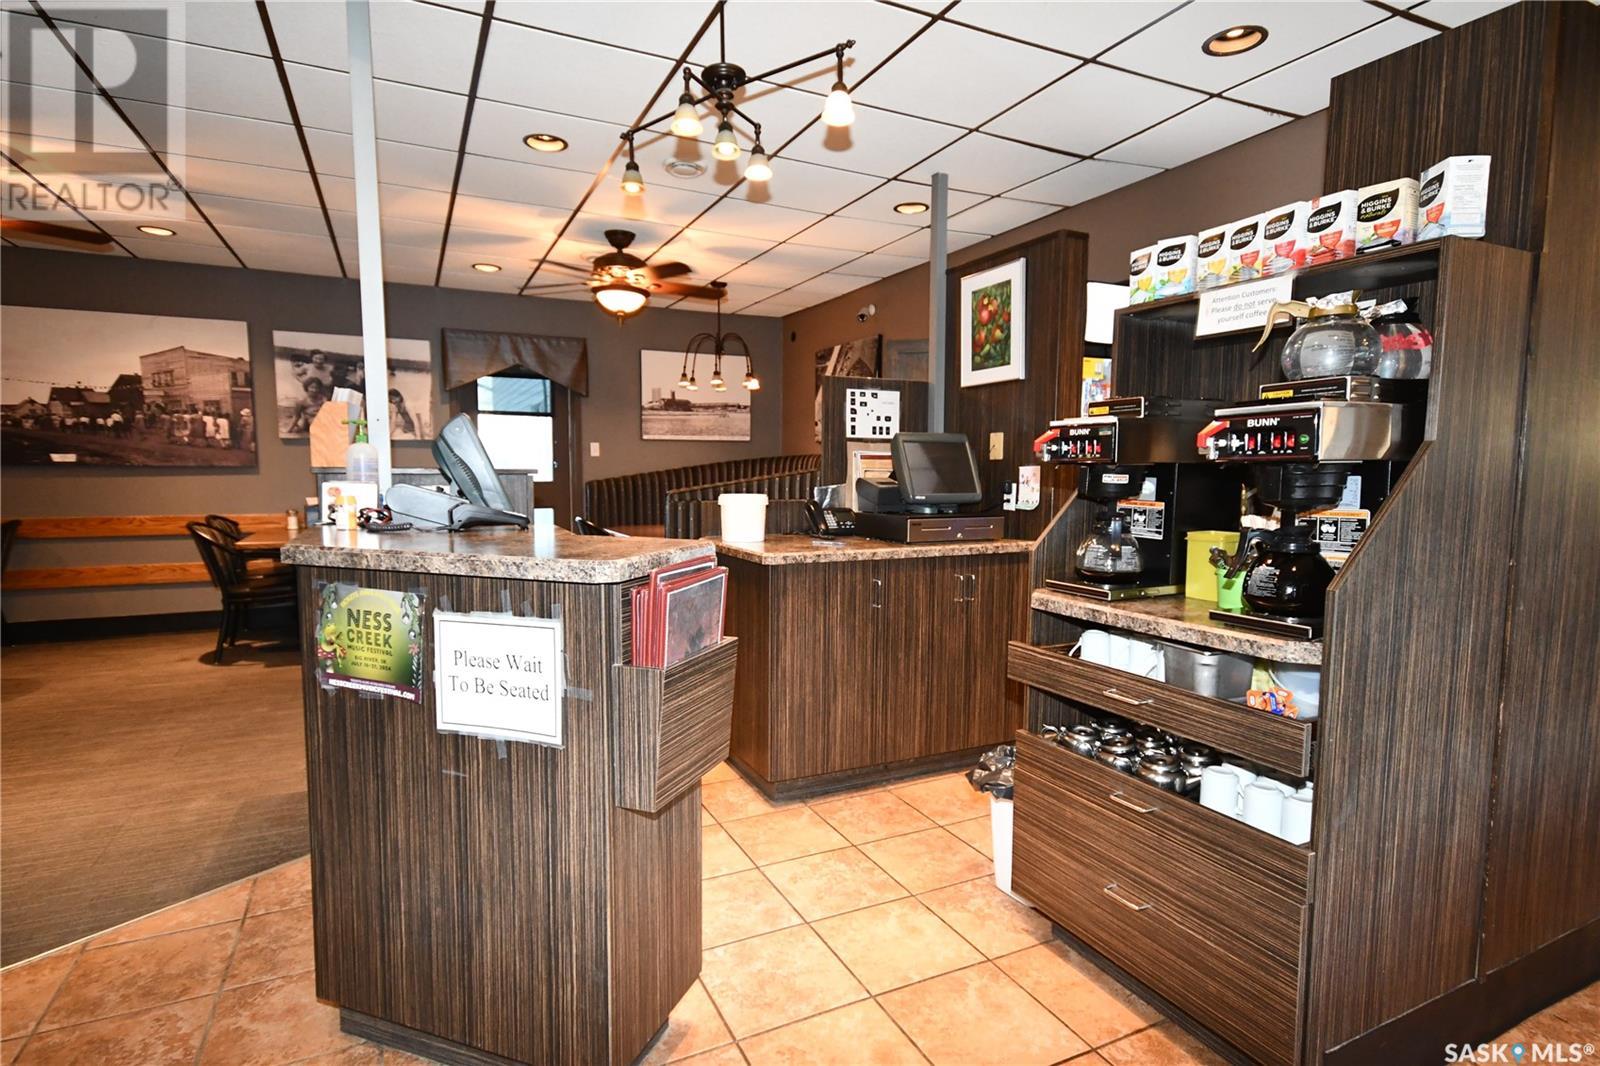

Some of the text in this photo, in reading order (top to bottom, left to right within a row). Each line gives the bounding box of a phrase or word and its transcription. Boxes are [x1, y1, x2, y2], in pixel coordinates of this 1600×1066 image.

[1361, 197, 1392, 208] HIGGINS
[1367, 203, 1392, 212] BURKE
[1212, 294, 1240, 303] Attention
[1211, 304, 1231, 313] Please
[1233, 303, 1243, 311] do
[1244, 301, 1256, 309] not
[1217, 312, 1244, 324] yourself
[346, 608, 392, 632] NESS
[347, 628, 392, 649] CREEK
[347, 644, 393, 657] MUSIC FESTIVAL
[454, 650, 542, 673] Please Wait
[448, 675, 549, 701] To Be Seated
